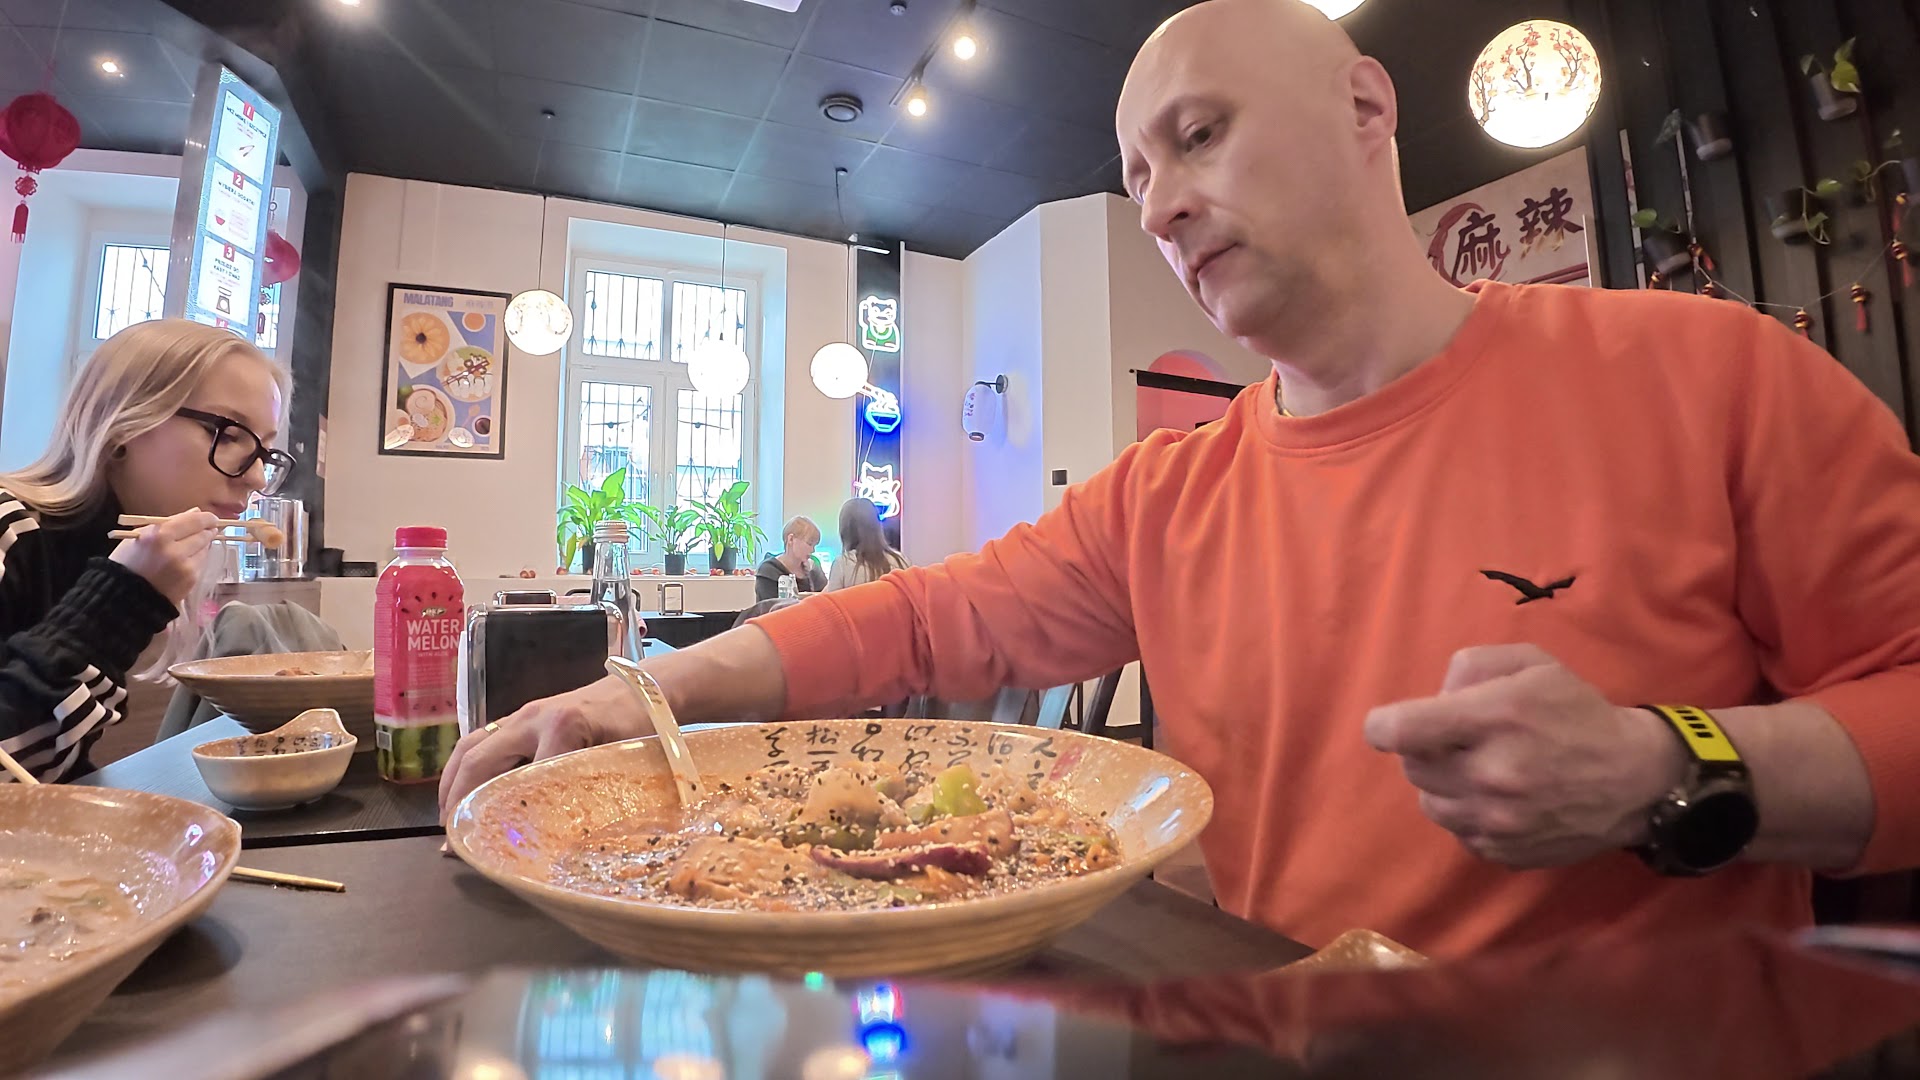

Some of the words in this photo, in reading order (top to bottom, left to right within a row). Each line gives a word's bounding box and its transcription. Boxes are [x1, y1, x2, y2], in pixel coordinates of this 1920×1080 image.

[403, 292, 454, 307] MALATANG
[406, 618, 460, 635] WATER
[407, 634, 460, 651] MELON
